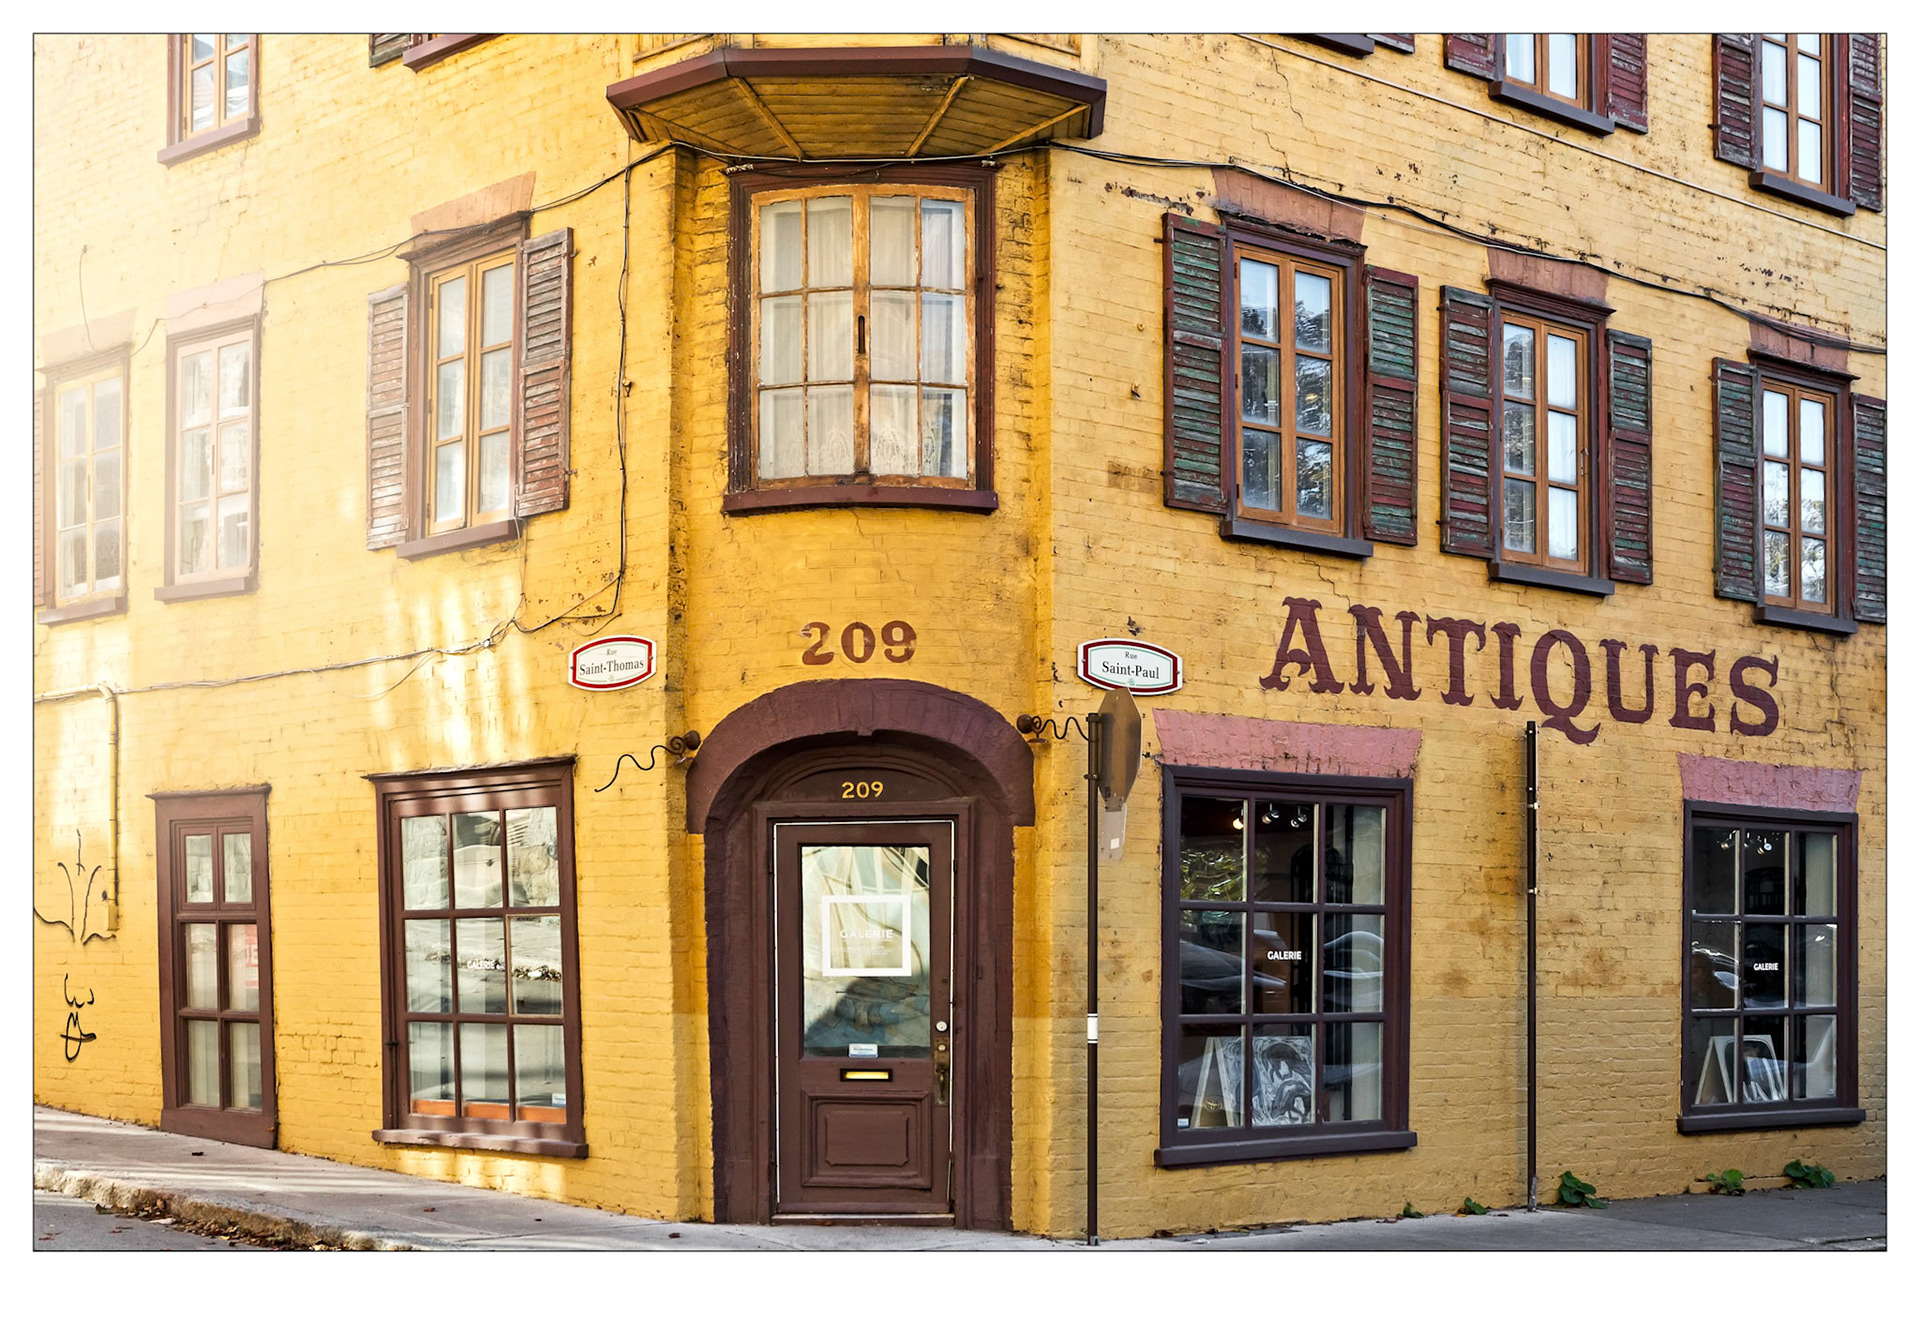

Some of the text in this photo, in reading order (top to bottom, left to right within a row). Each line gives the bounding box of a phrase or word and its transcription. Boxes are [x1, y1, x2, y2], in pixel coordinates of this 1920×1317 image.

[801, 620, 917, 666] 209
[606, 648, 618, 656] Rue
[1124, 651, 1138, 660] Rue
[579, 659, 644, 676] Saint-Thomas
[1101, 660, 1160, 680] Saint-Paul
[1259, 596, 1780, 745] ANTIQUES
[841, 781, 884, 799] 209
[839, 929, 894, 939] GALERIE
[1267, 950, 1302, 960] GALERIE
[466, 959, 496, 970] GALERIE
[1753, 962, 1779, 971] GALERIE
